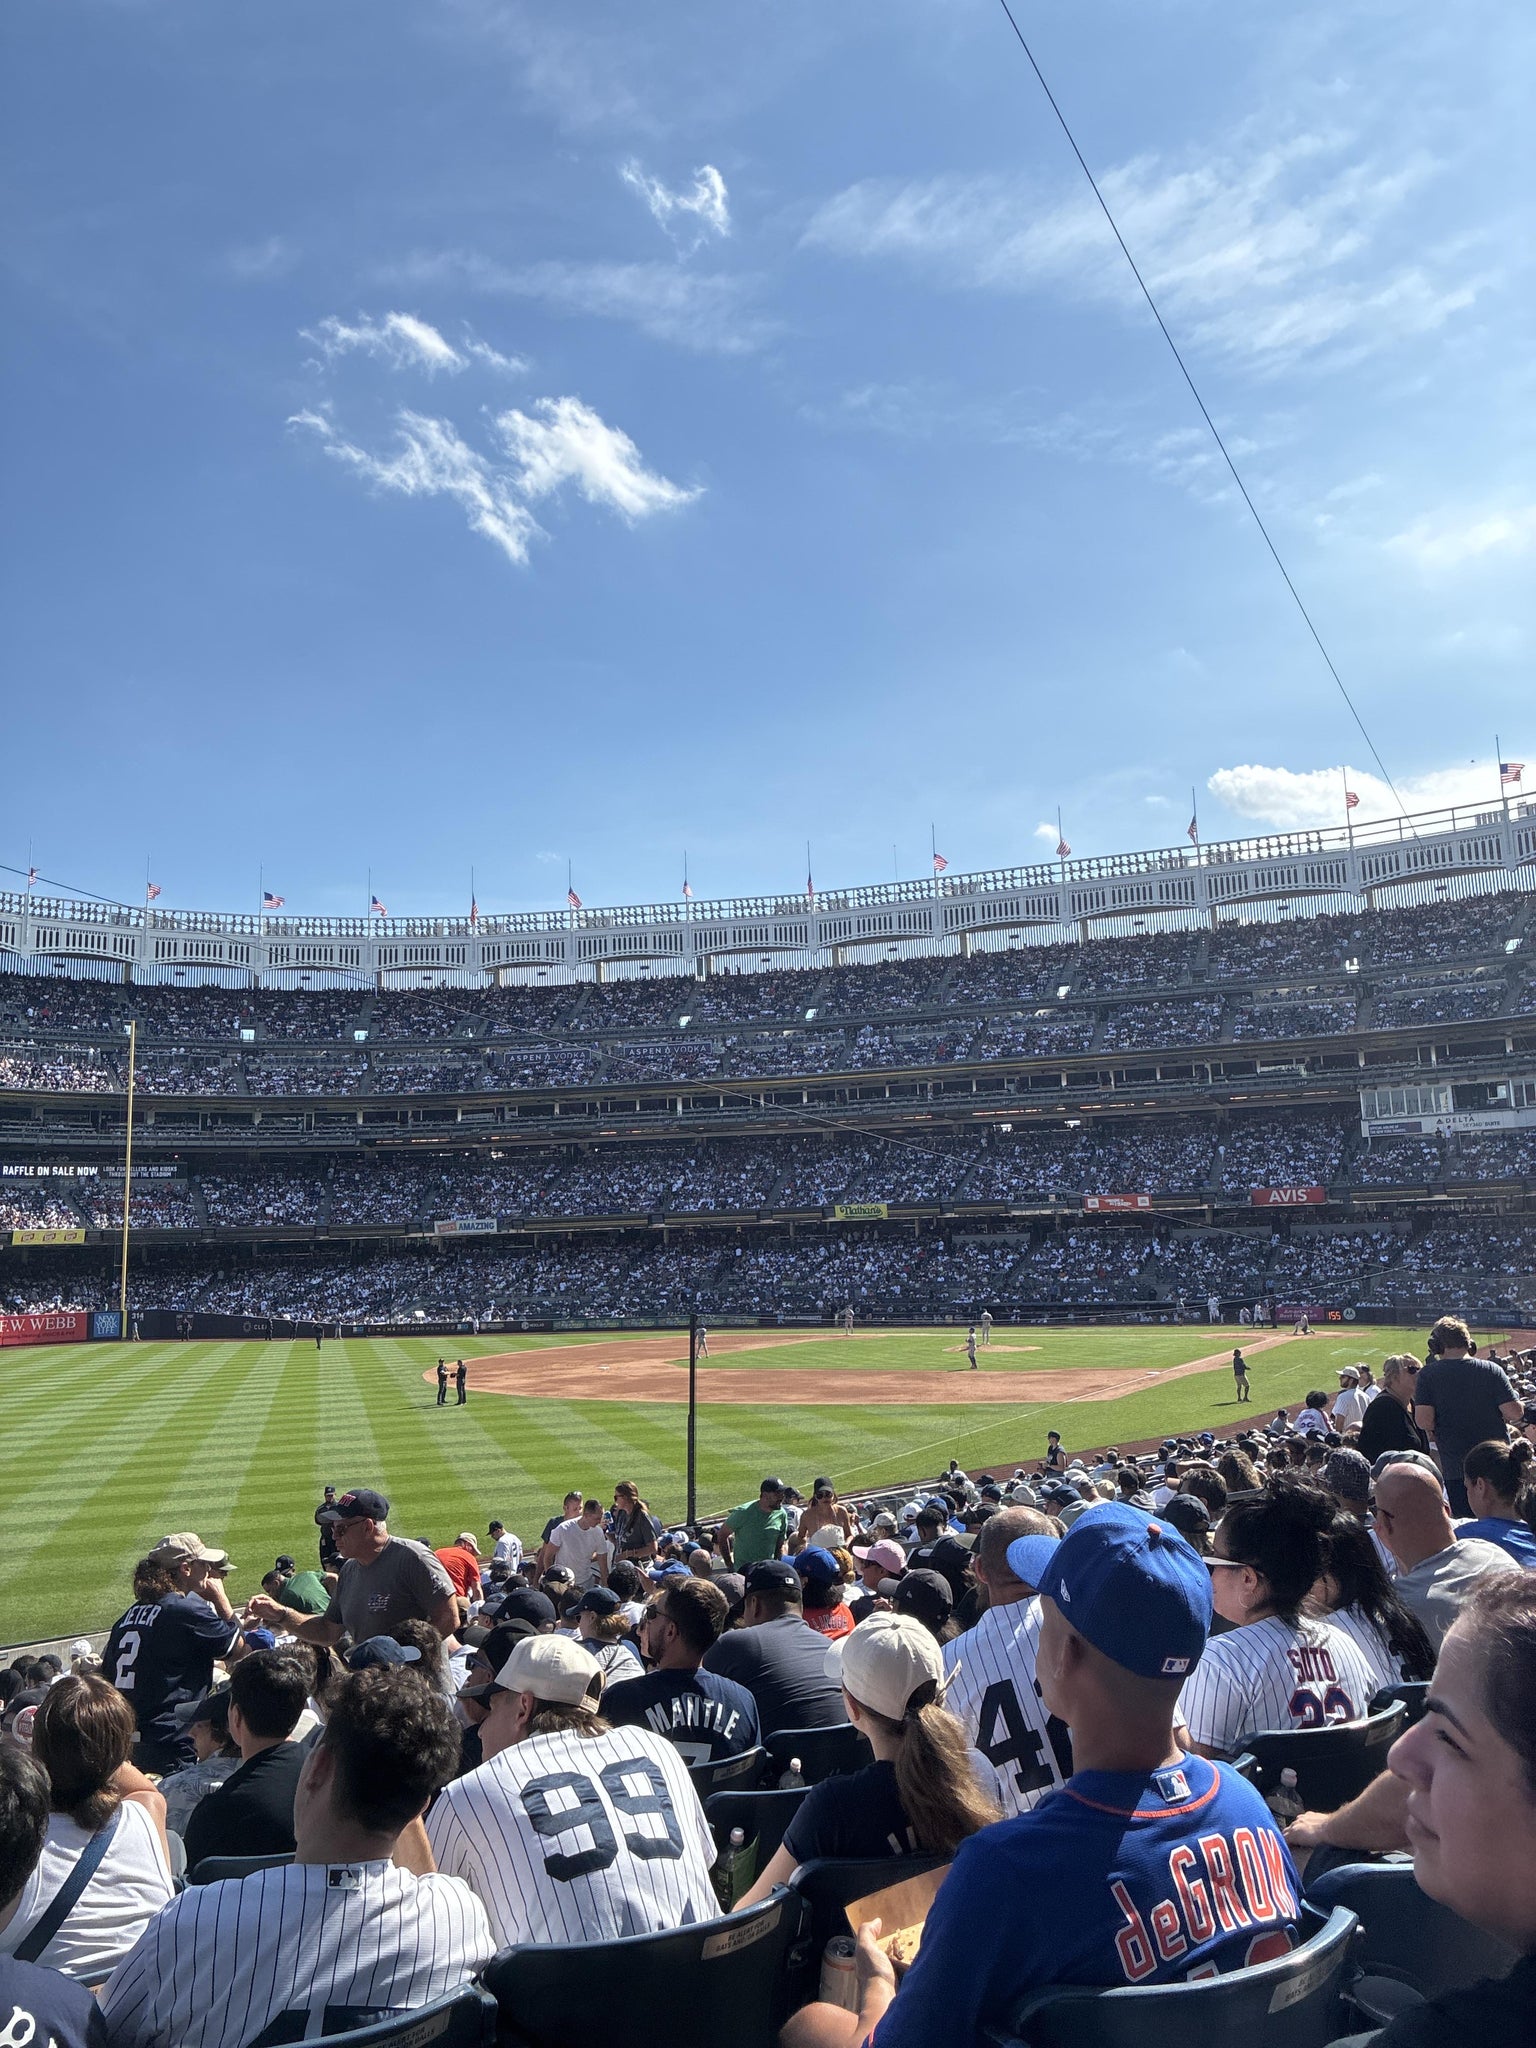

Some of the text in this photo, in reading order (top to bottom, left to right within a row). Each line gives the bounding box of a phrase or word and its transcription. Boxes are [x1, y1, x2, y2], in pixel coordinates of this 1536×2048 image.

[509, 1051, 586, 1062] ASPEN VODKA
[629, 1045, 707, 1056] ASPEN VODKA
[1445, 1116, 1475, 1124] DELTA
[3, 1166, 98, 1176] RAFFLE ON SALE NOW
[1268, 1188, 1308, 1203] AVIS
[840, 1205, 883, 1217] Nathan's
[458, 1221, 495, 1231] AMAZING
[27, 1316, 77, 1331] WEBB
[96, 1320, 118, 1329] YORK
[97, 1326, 115, 1335] LIFE
[119, 1604, 162, 1629] JETER
[114, 1630, 141, 1689] 2
[1286, 1646, 1340, 1684] SOTO
[645, 1696, 741, 1740] MANTLE
[519, 1756, 685, 1883] 99
[1110, 1826, 1297, 1983] deGROM
